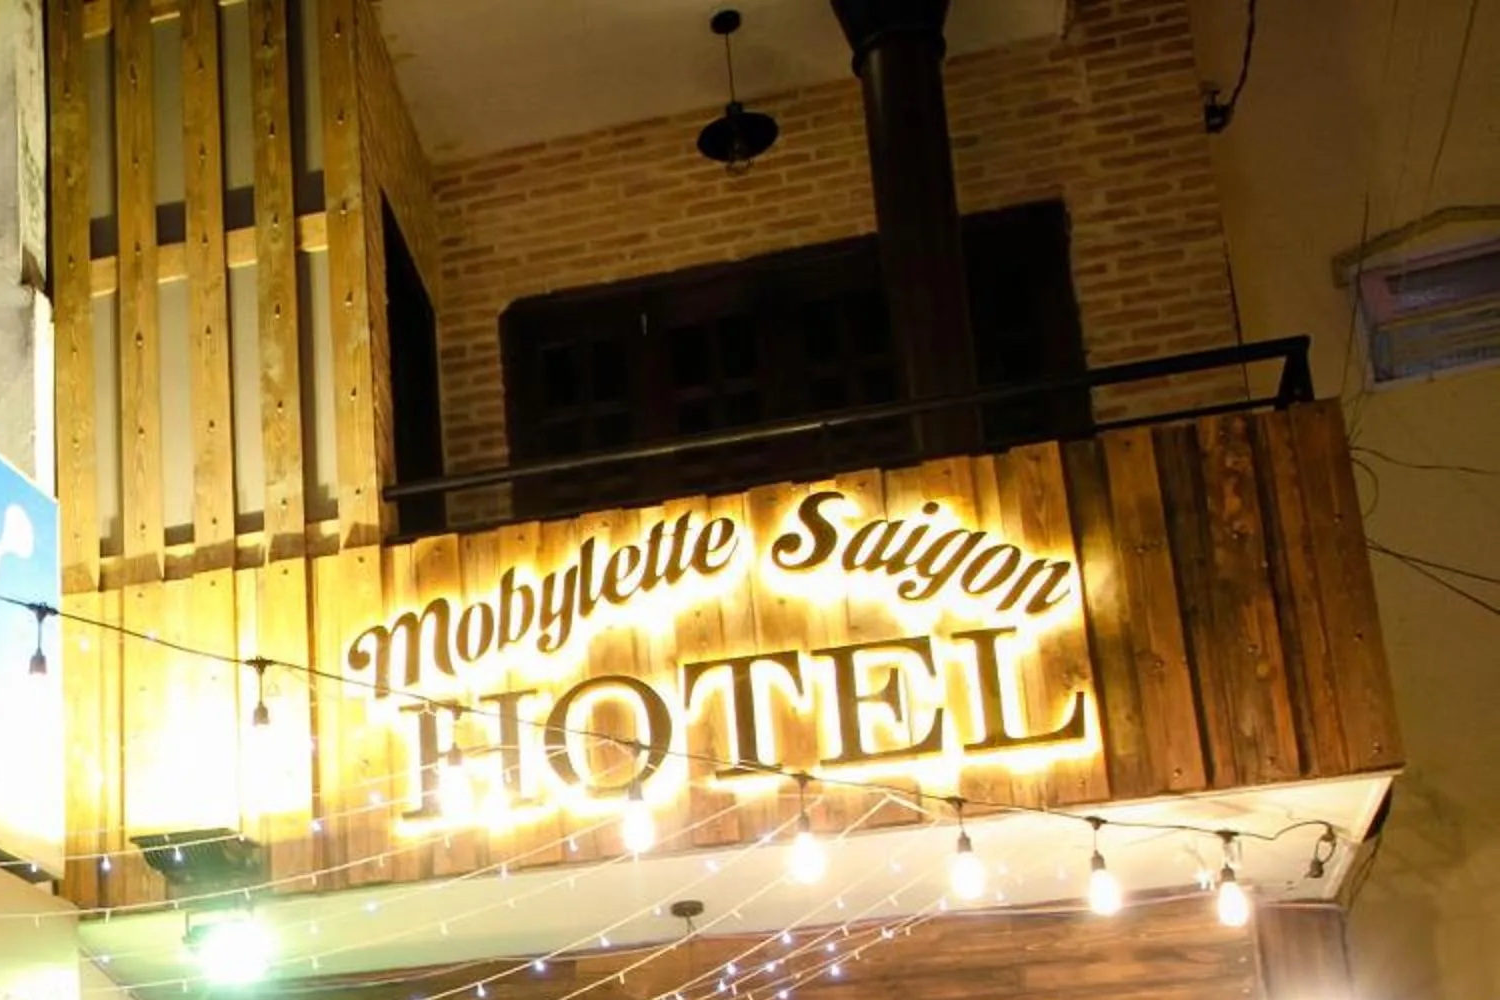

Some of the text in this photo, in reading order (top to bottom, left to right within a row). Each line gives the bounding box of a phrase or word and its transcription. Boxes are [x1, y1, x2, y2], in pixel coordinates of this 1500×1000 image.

[348, 490, 1079, 698] Mobylette Saigon
[398, 626, 1089, 822] HOTEL
